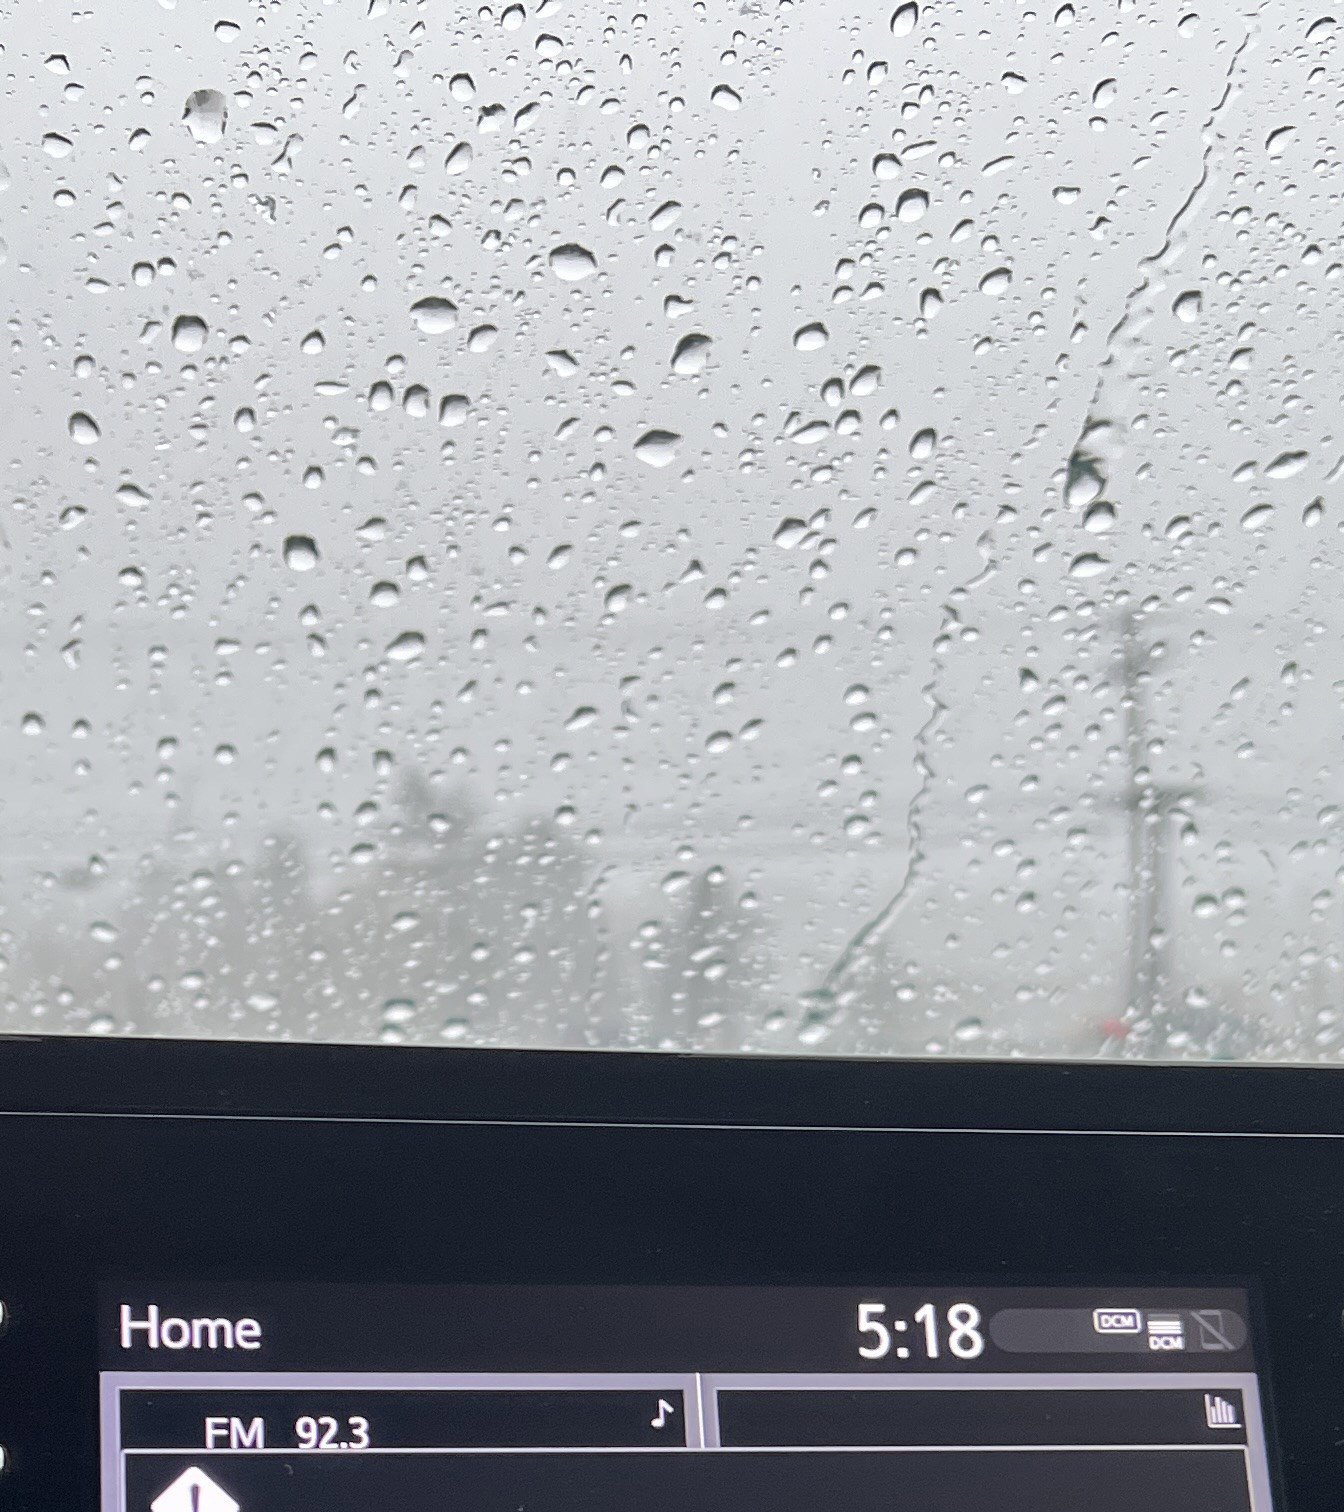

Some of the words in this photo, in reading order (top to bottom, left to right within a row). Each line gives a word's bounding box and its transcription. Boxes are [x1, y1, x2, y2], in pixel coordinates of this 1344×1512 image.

[119, 1304, 262, 1350] Home
[857, 1302, 986, 1360] 5:18
[1100, 1314, 1135, 1328] DCM
[1149, 1335, 1185, 1350] DCM
[204, 1416, 264, 1449] FM
[294, 1415, 371, 1449] 92.3
